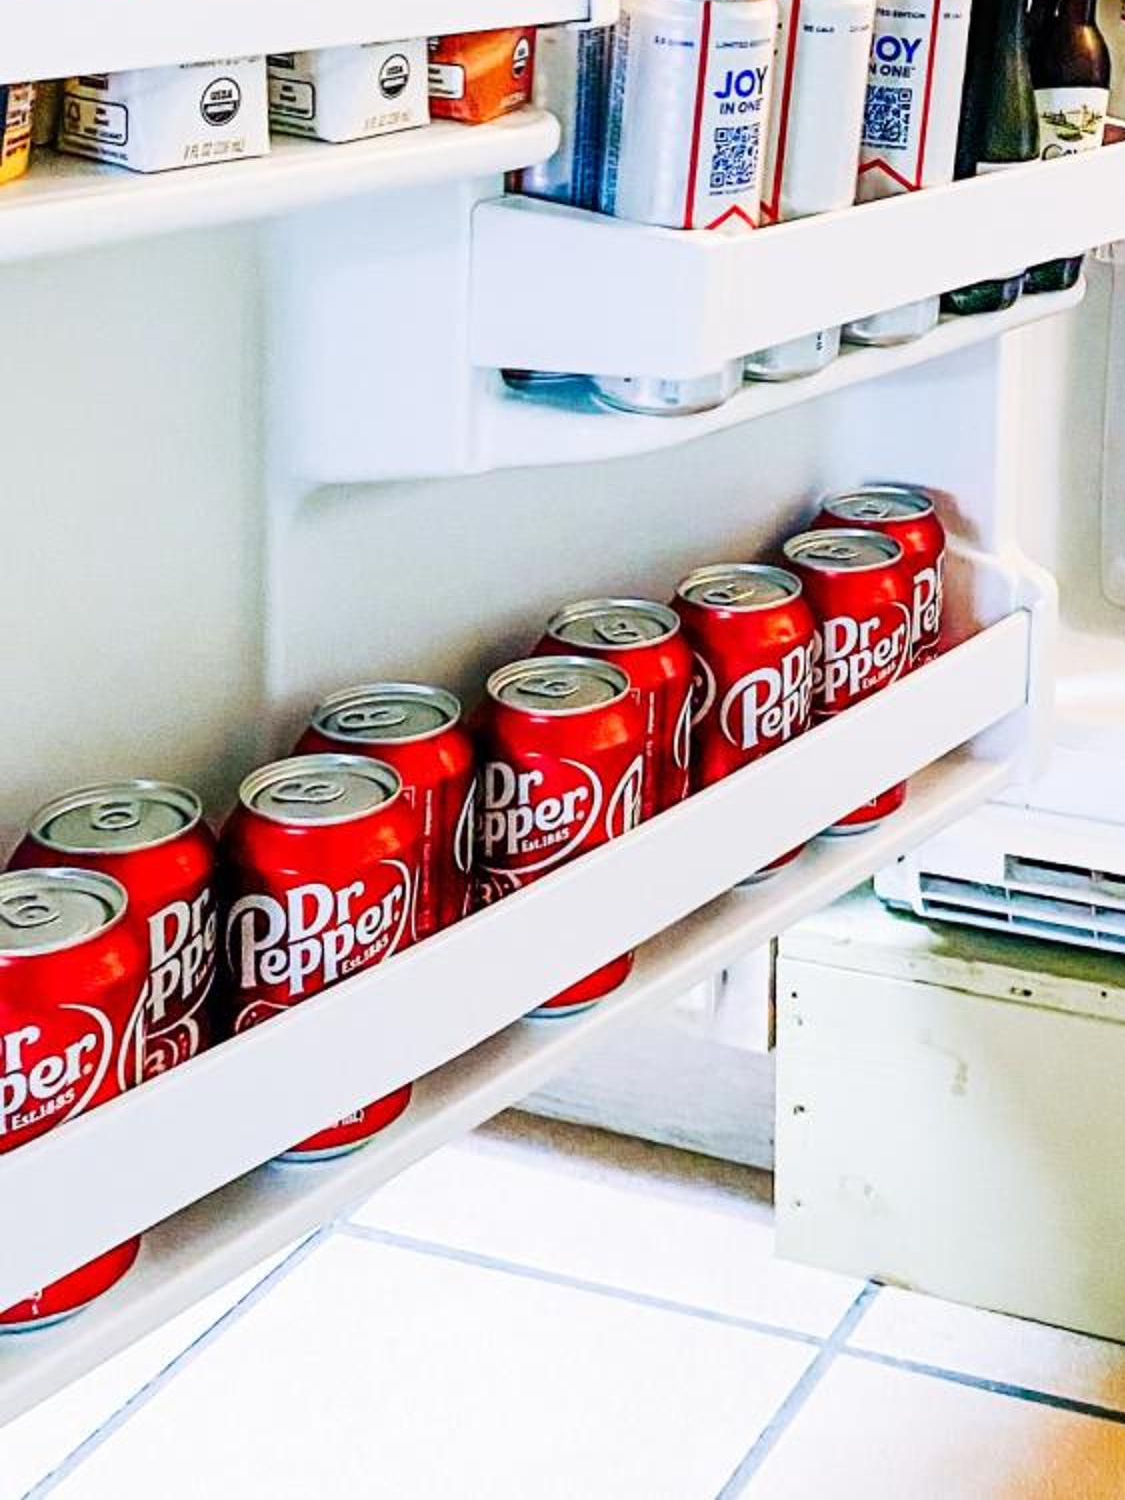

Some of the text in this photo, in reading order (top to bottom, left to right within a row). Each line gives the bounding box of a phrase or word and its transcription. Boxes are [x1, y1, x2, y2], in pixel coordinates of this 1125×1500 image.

[870, 36, 922, 63] OY
[714, 66, 769, 100] JOY
[879, 66, 911, 79] ONE
[719, 98, 762, 115] IN ONE
[823, 616, 881, 663] Dr
[484, 761, 543, 809] Dr
[148, 887, 210, 972] Dr
[286, 880, 365, 947] Dr
